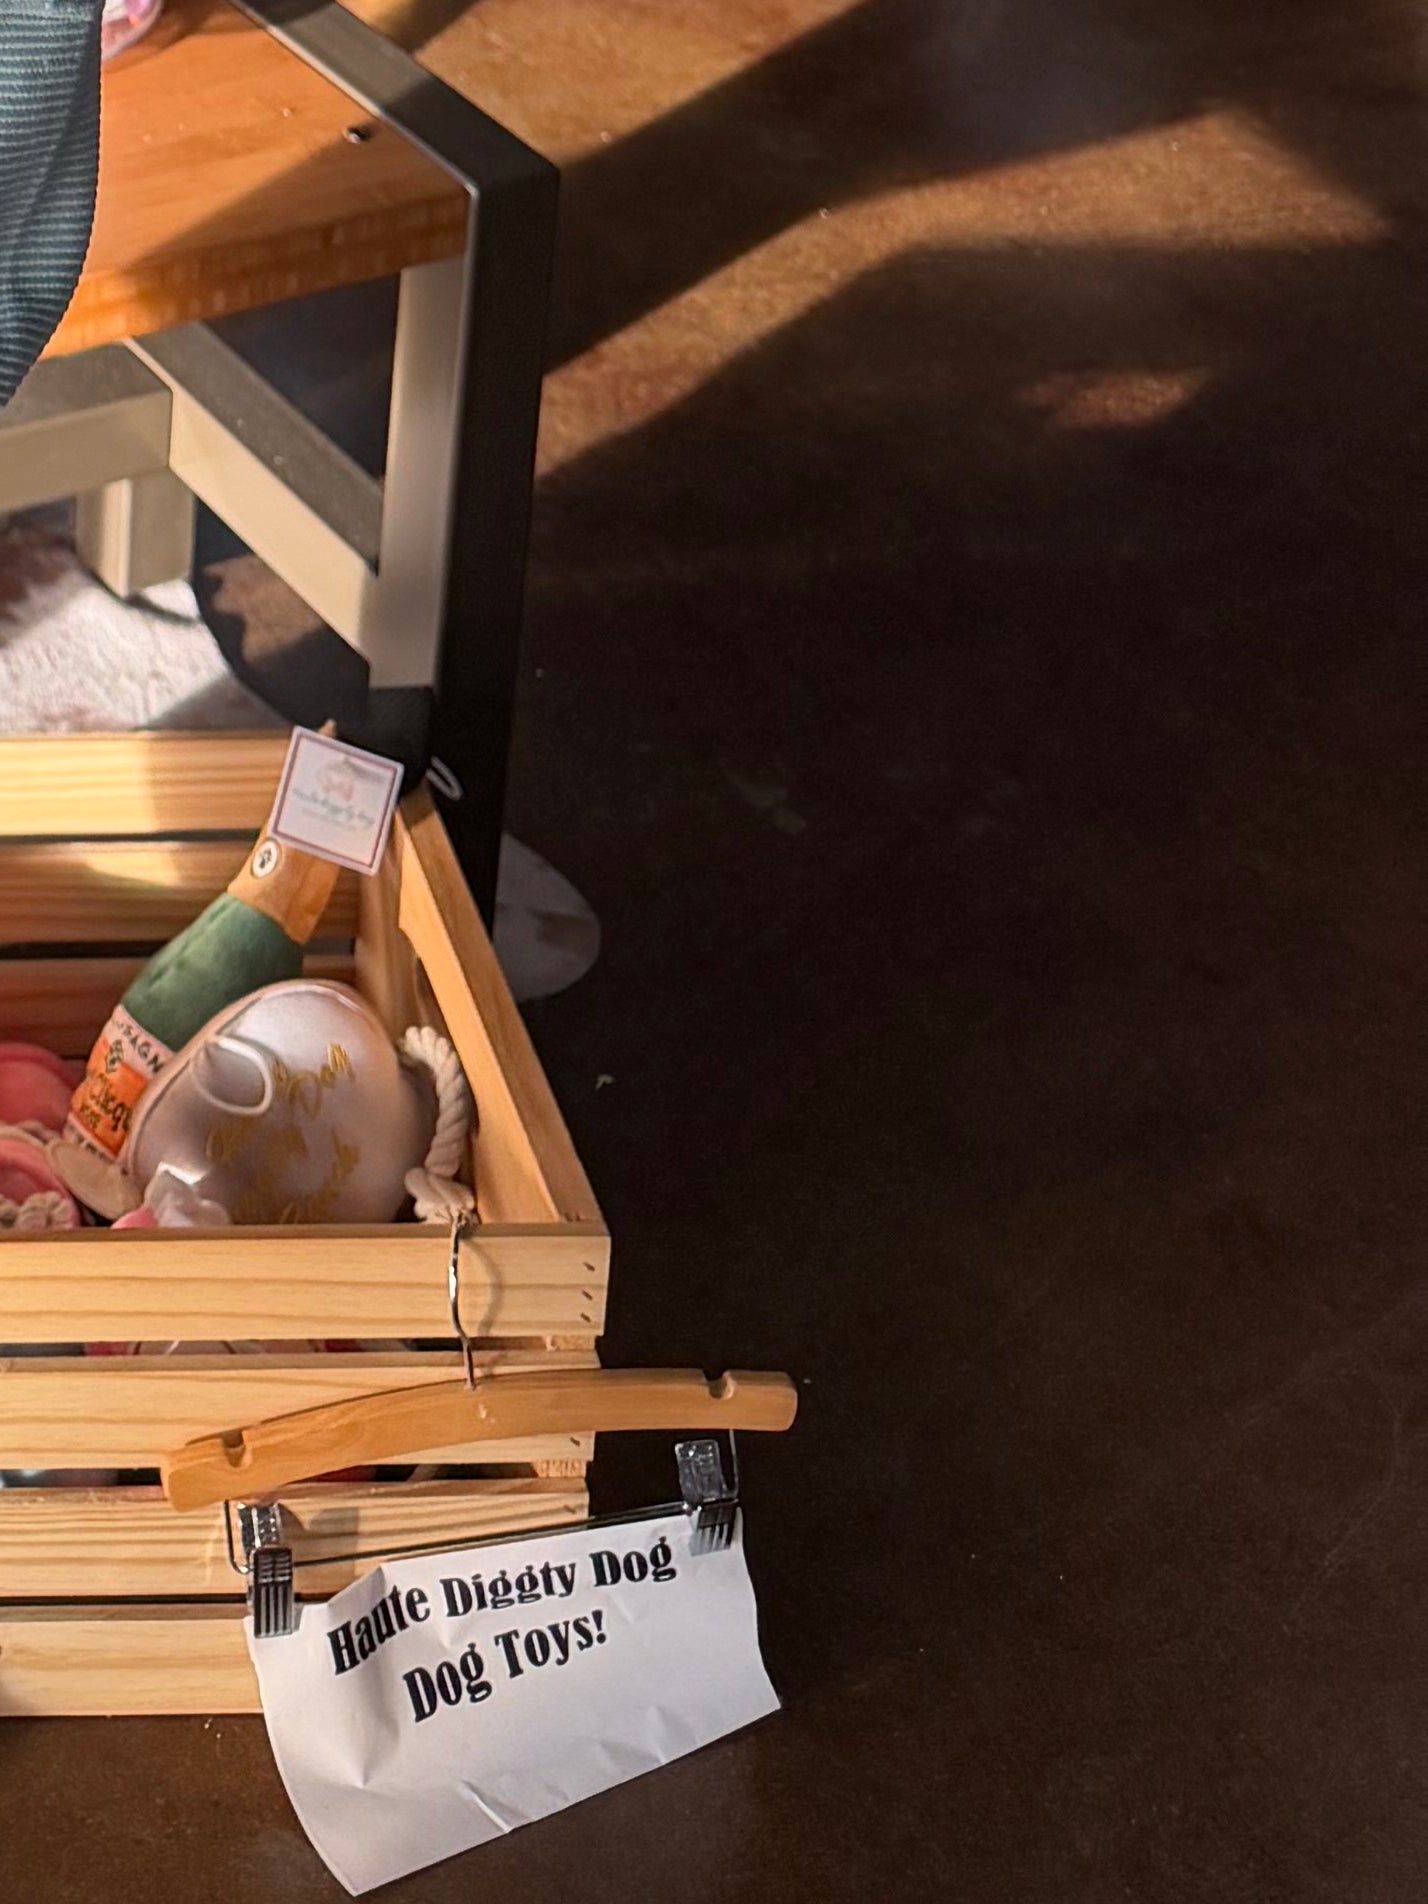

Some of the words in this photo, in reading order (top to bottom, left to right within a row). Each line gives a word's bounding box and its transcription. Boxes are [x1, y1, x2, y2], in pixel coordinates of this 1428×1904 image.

[327, 1584, 431, 1676] Haute
[439, 1561, 577, 1619] Diggty
[589, 1536, 678, 1588] Dog
[402, 1642, 494, 1723] Dog
[494, 1609, 609, 1679] Toys!
